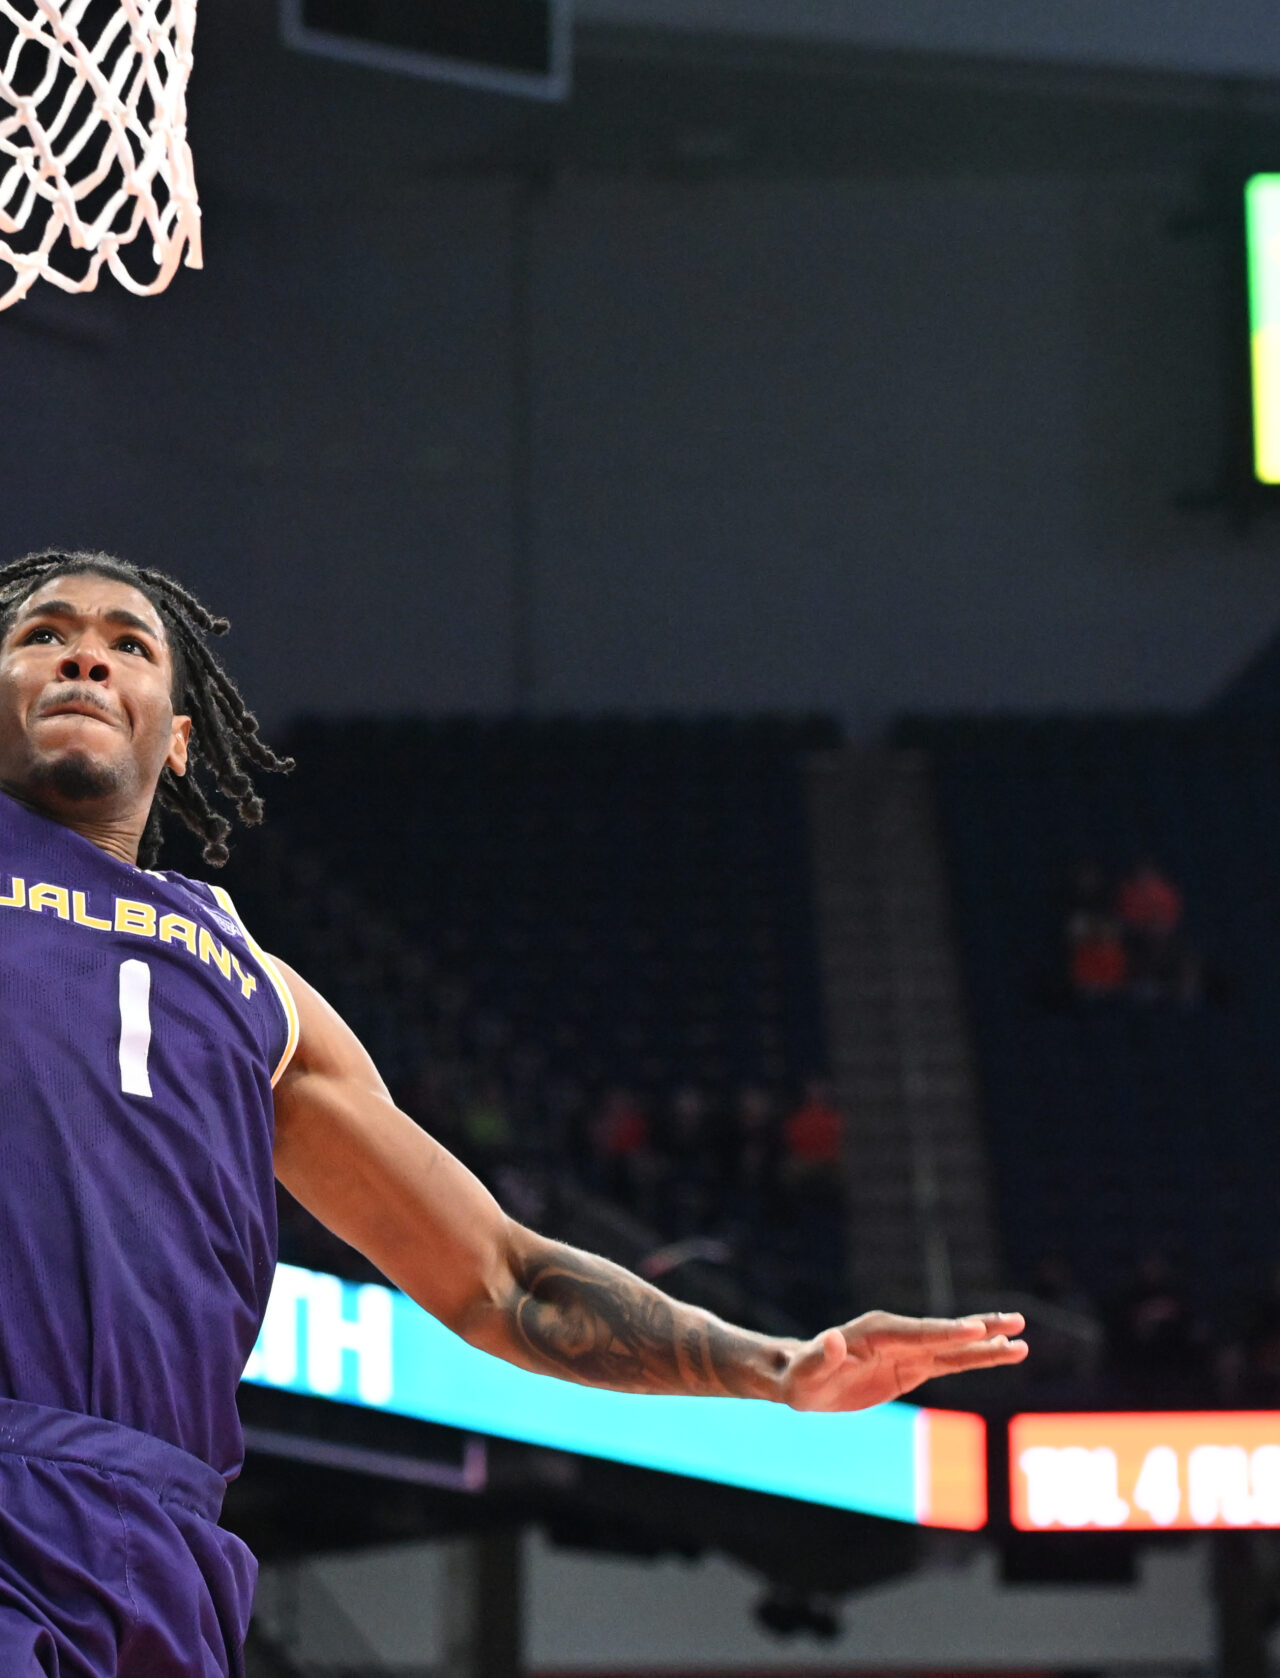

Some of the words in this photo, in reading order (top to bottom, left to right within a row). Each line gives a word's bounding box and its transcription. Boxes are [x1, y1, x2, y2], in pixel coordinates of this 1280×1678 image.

[119, 958, 153, 1099] 1
[240, 1262, 392, 1405] TH
[1134, 1446, 1181, 1525] 4
